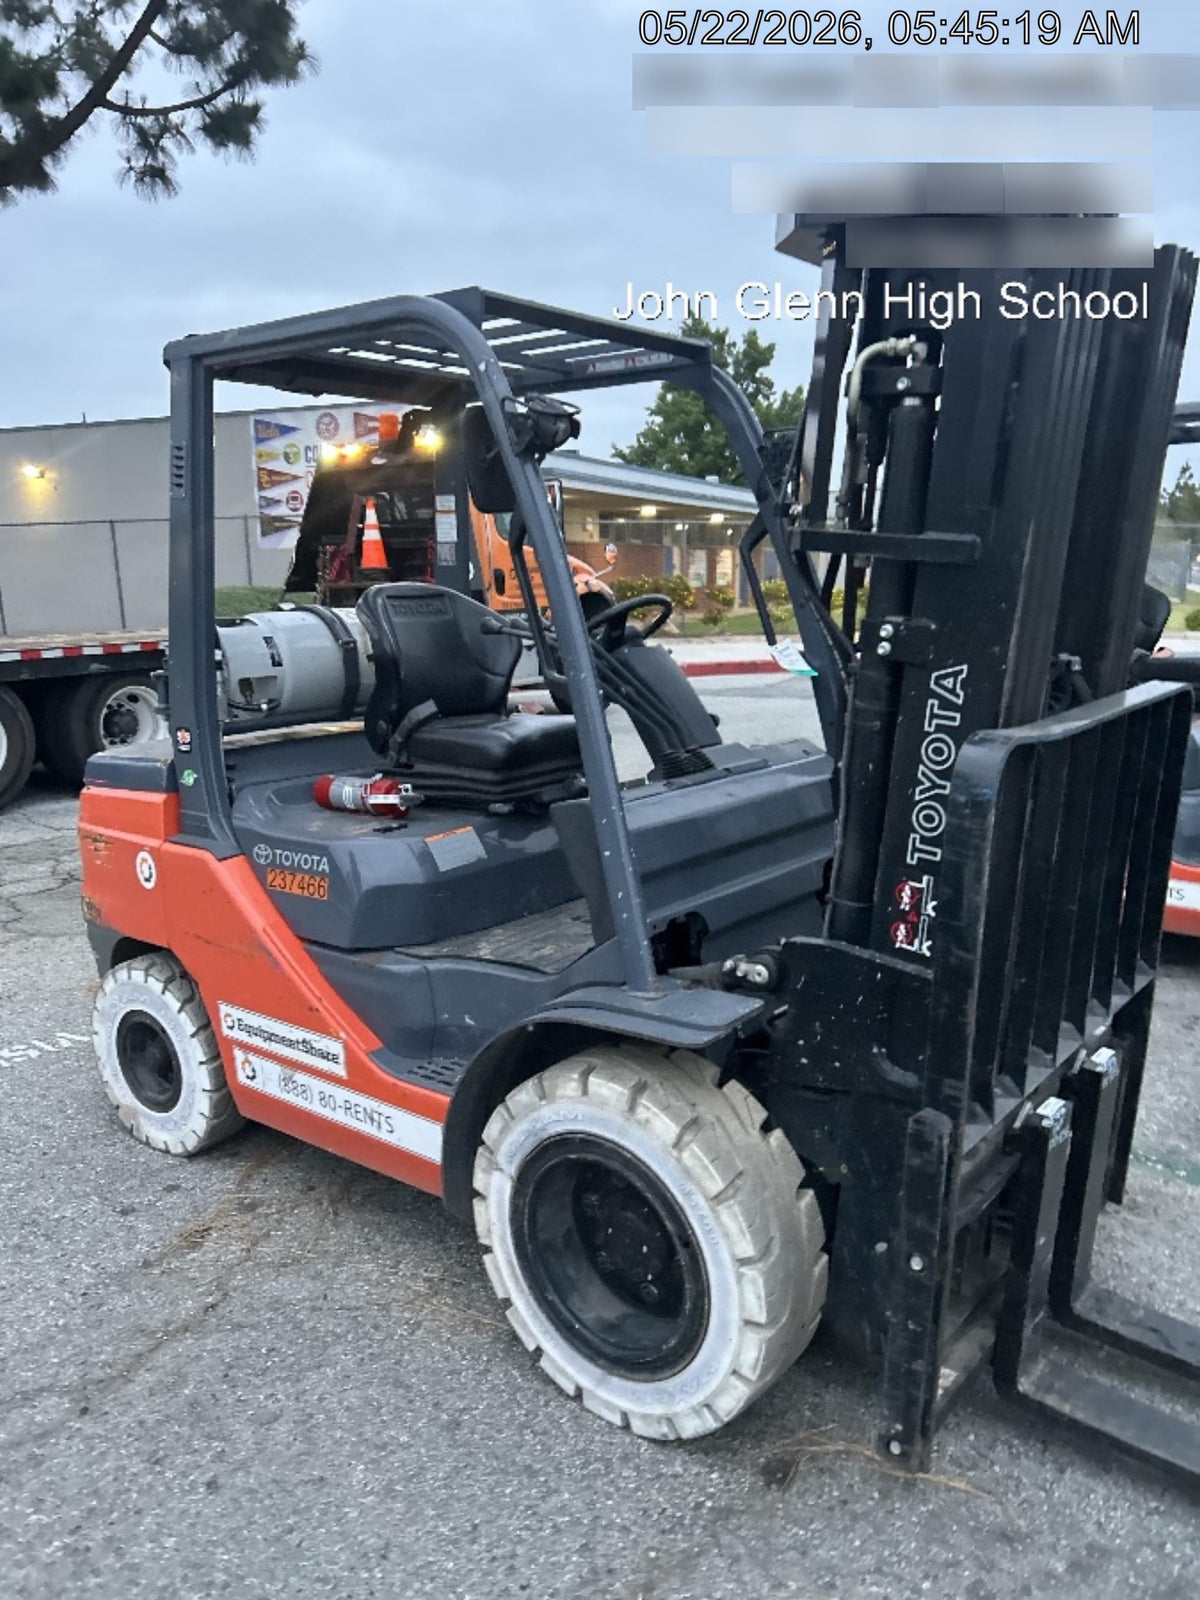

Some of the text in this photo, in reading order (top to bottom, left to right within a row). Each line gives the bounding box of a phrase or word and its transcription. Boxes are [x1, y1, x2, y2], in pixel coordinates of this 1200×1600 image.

[906, 664, 968, 865] TOYOTA
[273, 848, 329, 873] TOYOTA
[268, 868, 327, 899] 237466
[237, 1017, 341, 1065] EquipmentShare
[318, 1090, 395, 1134] 80-RENTS
